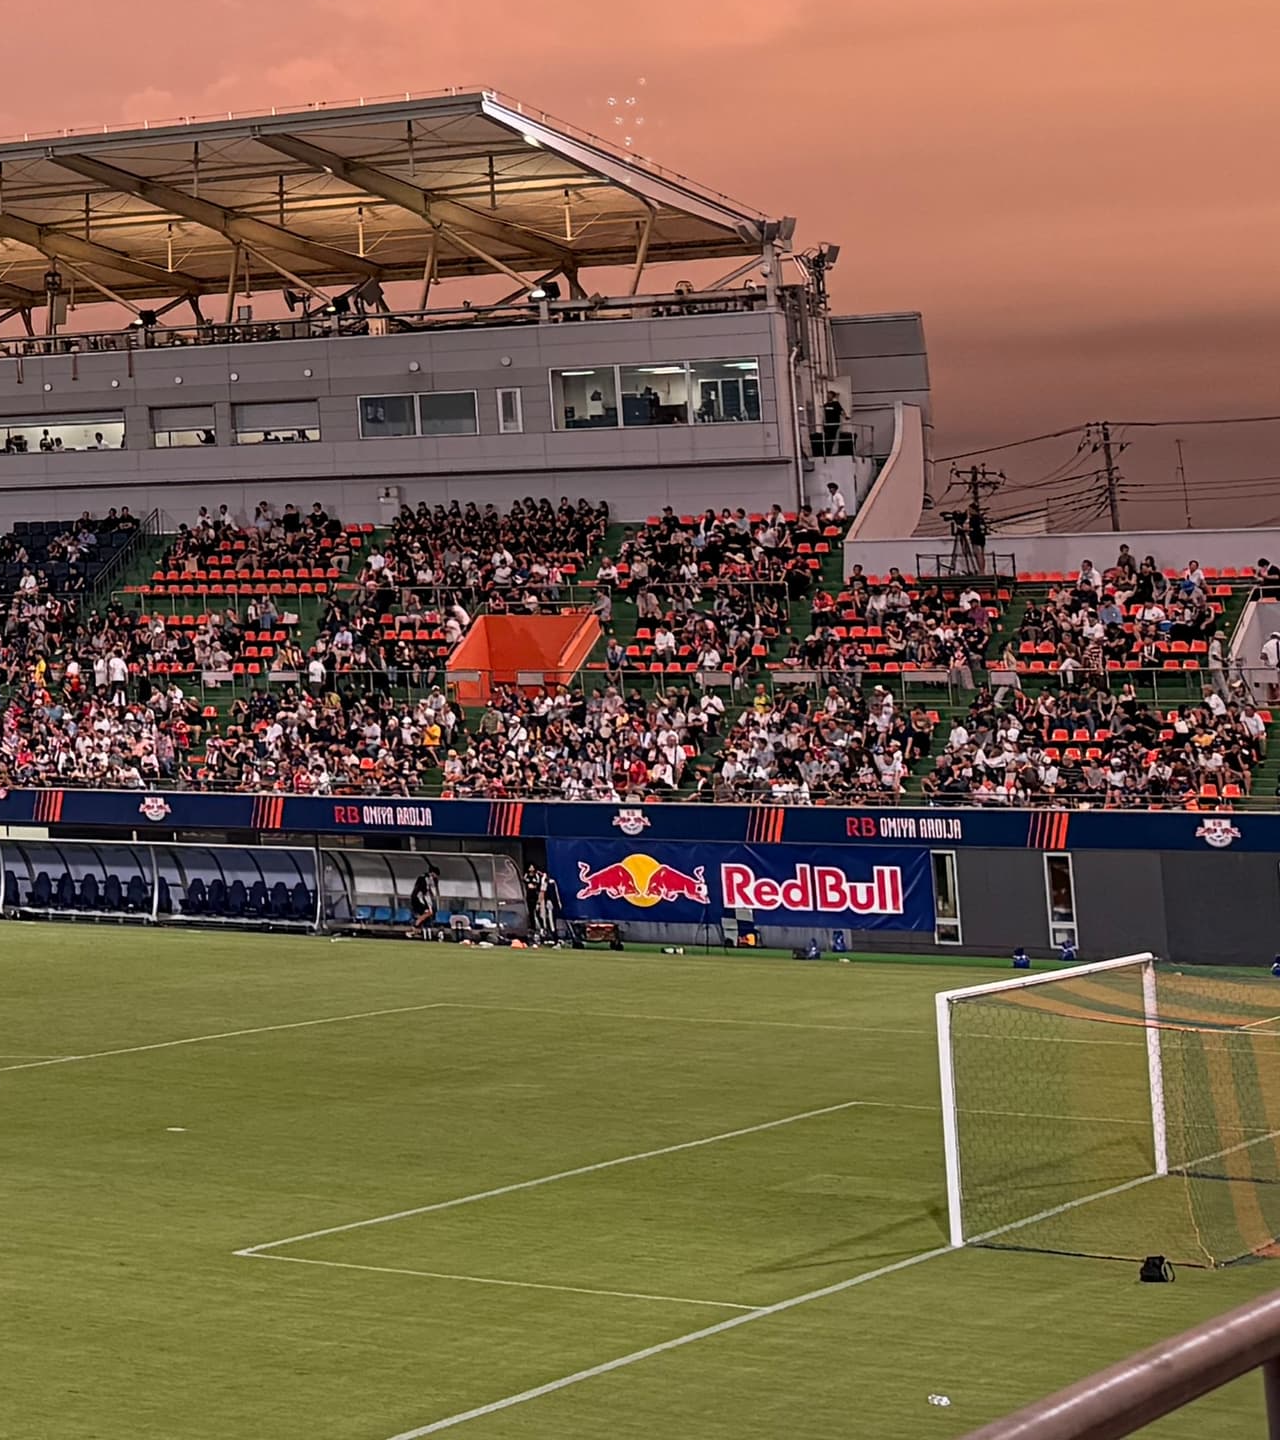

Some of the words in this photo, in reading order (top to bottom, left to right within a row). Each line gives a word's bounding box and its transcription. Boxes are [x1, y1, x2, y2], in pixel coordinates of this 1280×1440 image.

[334, 806, 360, 824] RB
[363, 806, 394, 825] OMIYA
[846, 817, 877, 837] RB
[880, 817, 917, 838] OMIYA
[920, 818, 962, 839] ARDIJA
